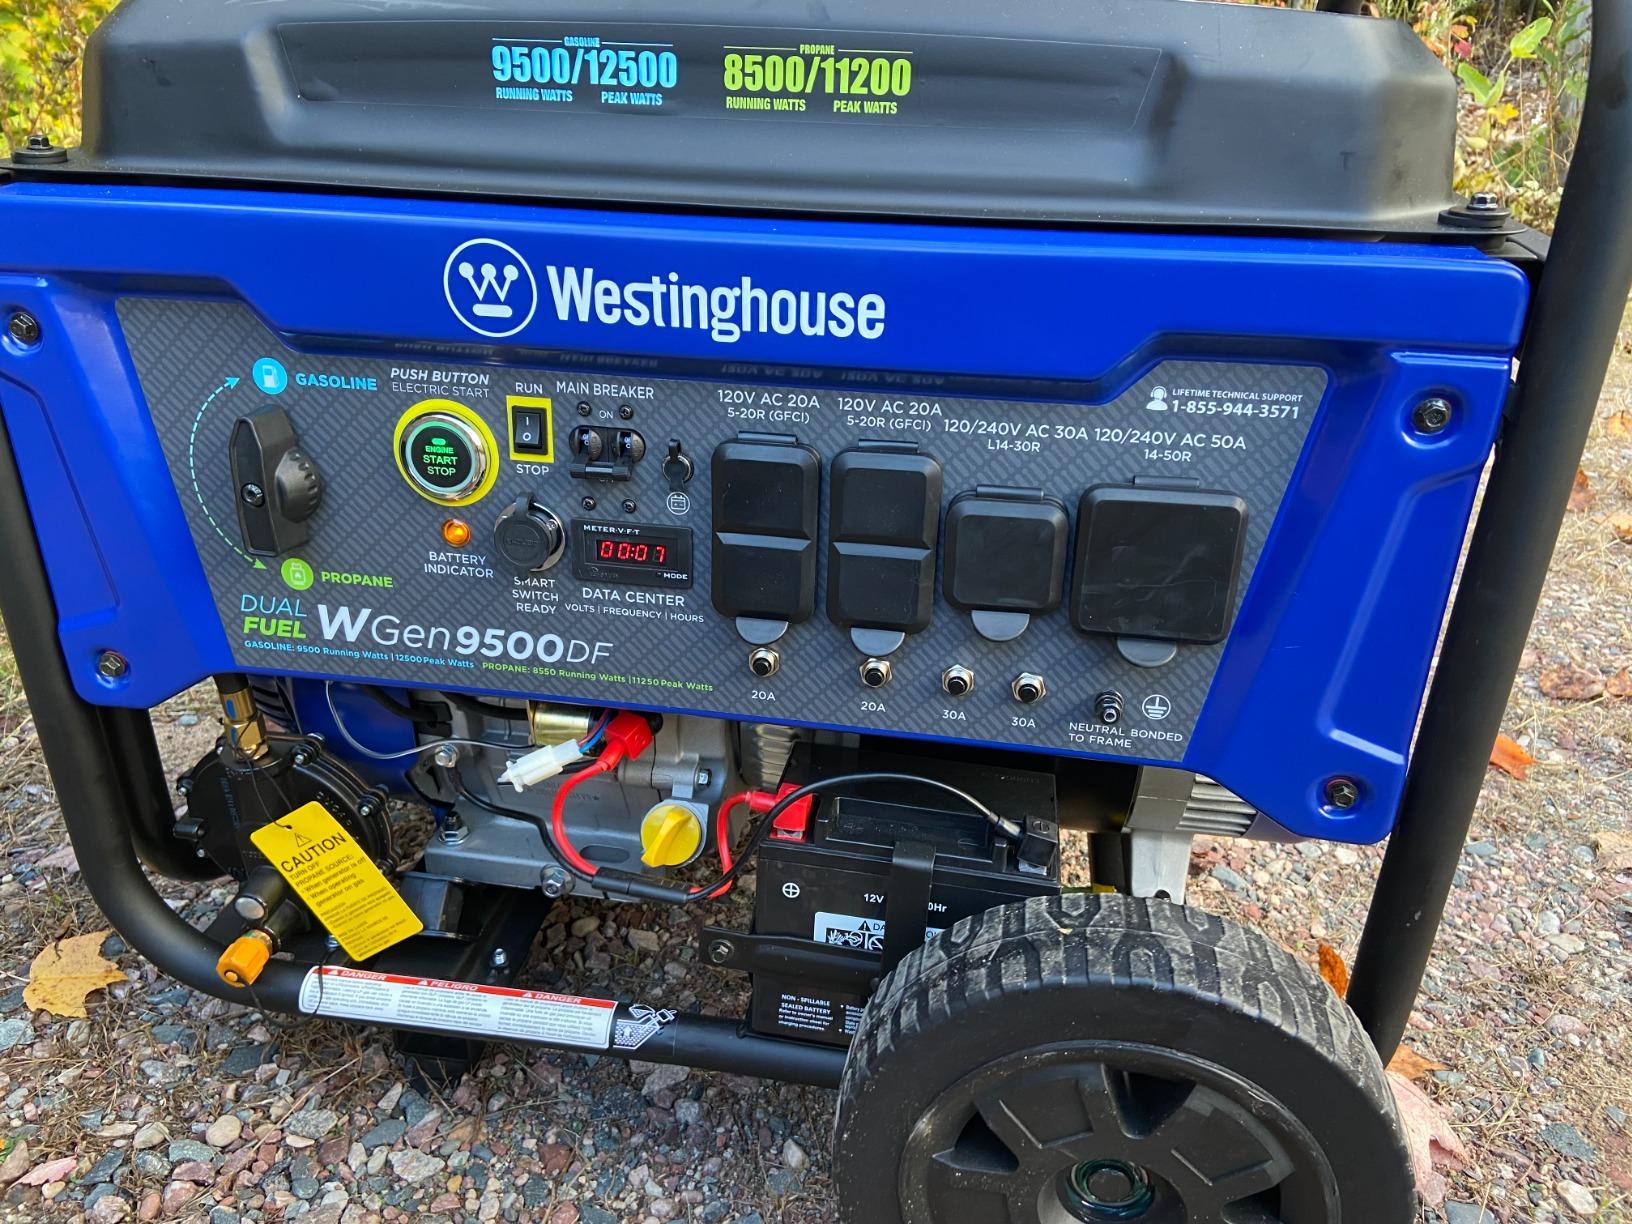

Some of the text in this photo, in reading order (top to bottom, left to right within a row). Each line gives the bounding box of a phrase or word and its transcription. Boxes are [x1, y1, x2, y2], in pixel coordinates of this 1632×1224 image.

[564, 36, 600, 48] GASOLINE
[799, 44, 835, 55] PROPANE
[491, 45, 677, 88] 9500/12500
[723, 53, 912, 96] 8500/11200
[496, 87, 663, 106] RUNNING WATTS PEAK WATTS
[726, 96, 898, 114] RUNNING WATTS PEAK WATTS
[546, 265, 886, 343] Westinghouse
[295, 373, 377, 391] GASOLINE
[390, 367, 490, 386] PUSH BUTTON
[392, 381, 489, 398] ELECTRIC START
[515, 382, 543, 394] RUN
[556, 381, 654, 400] MAIN BREAKER
[1172, 388, 1303, 403] LIFETIME TECHNICAL SUPPORT
[717, 389, 820, 409] 120V AC 20A
[837, 397, 942, 416] 120V AC 20A
[599, 410, 614, 419] ON
[727, 407, 810, 424] 5-20R (GFCI)
[1172, 399, 1300, 420] 1-855-944-3571
[846, 415, 932, 432] 5-20R (GFCI)
[943, 419, 1089, 441] 120/240V AC 30A
[987, 439, 1041, 453] L14-30R
[1094, 427, 1247, 450] 120/240V AC 50A
[425, 445, 454, 454] ENGINE
[1143, 449, 1192, 463] 14-50R
[423, 454, 458, 465] START
[427, 466, 456, 476] STOP
[516, 464, 550, 476] STOP
[429, 551, 486, 565] BATTERY
[600, 540, 667, 563] 00:07
[424, 563, 494, 579] INDICATOR
[663, 572, 688, 580] MODE
[320, 571, 394, 588] PROPANE
[513, 576, 556, 588] SMART
[512, 589, 559, 602] SWITCH
[582, 587, 685, 607] DATA CENTER
[240, 594, 308, 617] DUAL
[516, 602, 557, 615] READY
[565, 603, 595, 613] VOLTS
[603, 606, 662, 620] FREQUENCY
[670, 613, 704, 623] HOURS
[243, 616, 307, 639] FUEL
[244, 640, 295, 652] GASOLINE:
[297, 645, 321, 654] 9500
[323, 647, 360, 659] Running
[361, 650, 388, 660] Watts
[423, 656, 445, 666] Peak
[447, 658, 475, 669] Watts
[482, 662, 531, 674] PROPANE:
[532, 666, 556, 676] 8550
[559, 669, 597, 681] Running
[598, 673, 626, 683] Watts
[660, 679, 683, 688] Peak
[685, 681, 713, 692] Watts
[751, 690, 776, 702] 20A
[860, 701, 887, 713] 20A
[942, 709, 967, 722] 30A
[1011, 717, 1036, 729] 30A
[1068, 721, 1183, 742] NEUTRAL BONDED
[1068, 733, 1132, 749] TO FRAME
[281, 832, 347, 873] CAUTION
[863, 893, 884, 903] 12V
[340, 969, 387, 981] DANGER
[430, 981, 479, 992] PELIGRO
[534, 992, 583, 1004] DANGER
[781, 1002, 831, 1014] SEALED BATTERY
